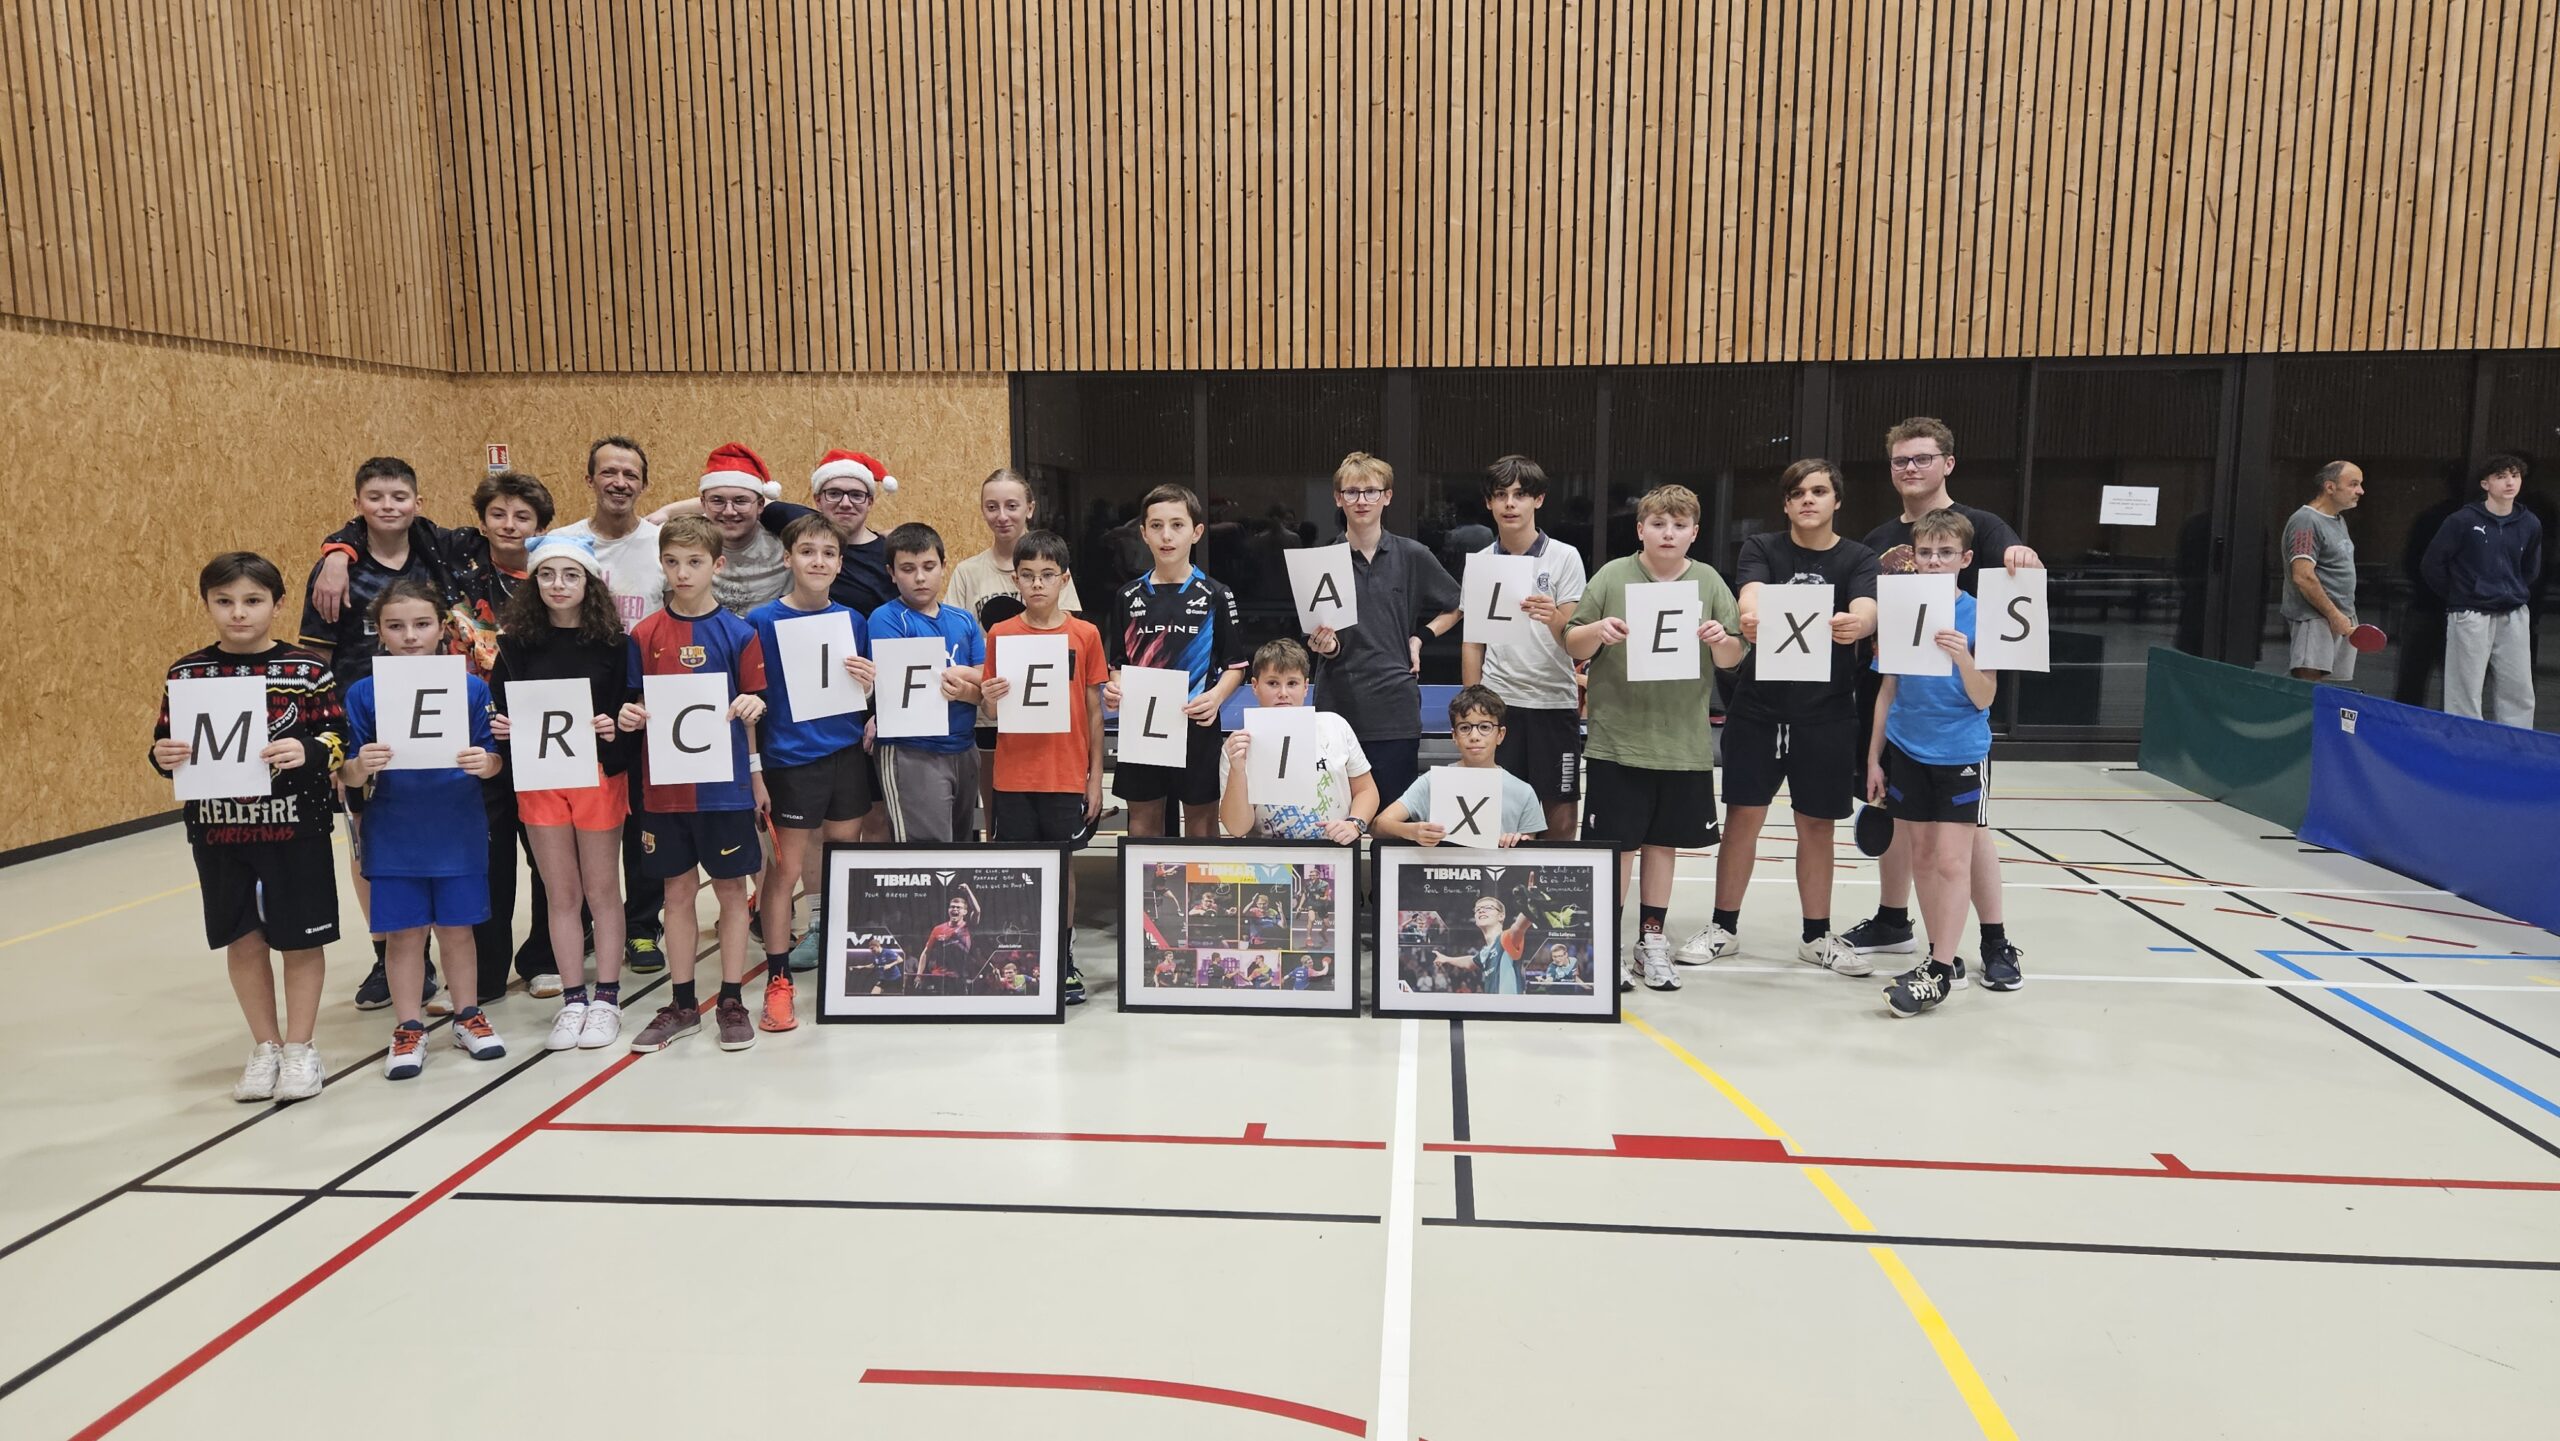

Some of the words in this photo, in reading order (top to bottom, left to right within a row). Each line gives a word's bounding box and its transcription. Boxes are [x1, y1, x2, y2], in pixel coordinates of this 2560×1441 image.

[1309, 573, 1342, 612] A
[1488, 583, 1511, 621] L
[1137, 625, 1199, 635] ALPINE
[1652, 610, 1683, 652] E
[1775, 613, 1820, 653] X
[1913, 604, 1927, 646] I
[2001, 596, 2032, 642] S
[821, 644, 829, 688] I
[902, 665, 932, 708] F
[1023, 664, 1054, 706] E
[410, 689, 448, 738] E
[672, 705, 716, 753] C
[1143, 697, 1168, 738] L
[190, 711, 252, 765] M
[538, 711, 575, 758] R
[1278, 737, 1290, 778] I
[1561, 752, 1574, 792] PUMA
[1450, 796, 1489, 834] X
[206, 826, 294, 846] CHRISTMAS
[874, 874, 931, 886] TIBHAR
[1198, 864, 1256, 876] TIBHAR
[1424, 868, 1481, 881] TIBHAR
